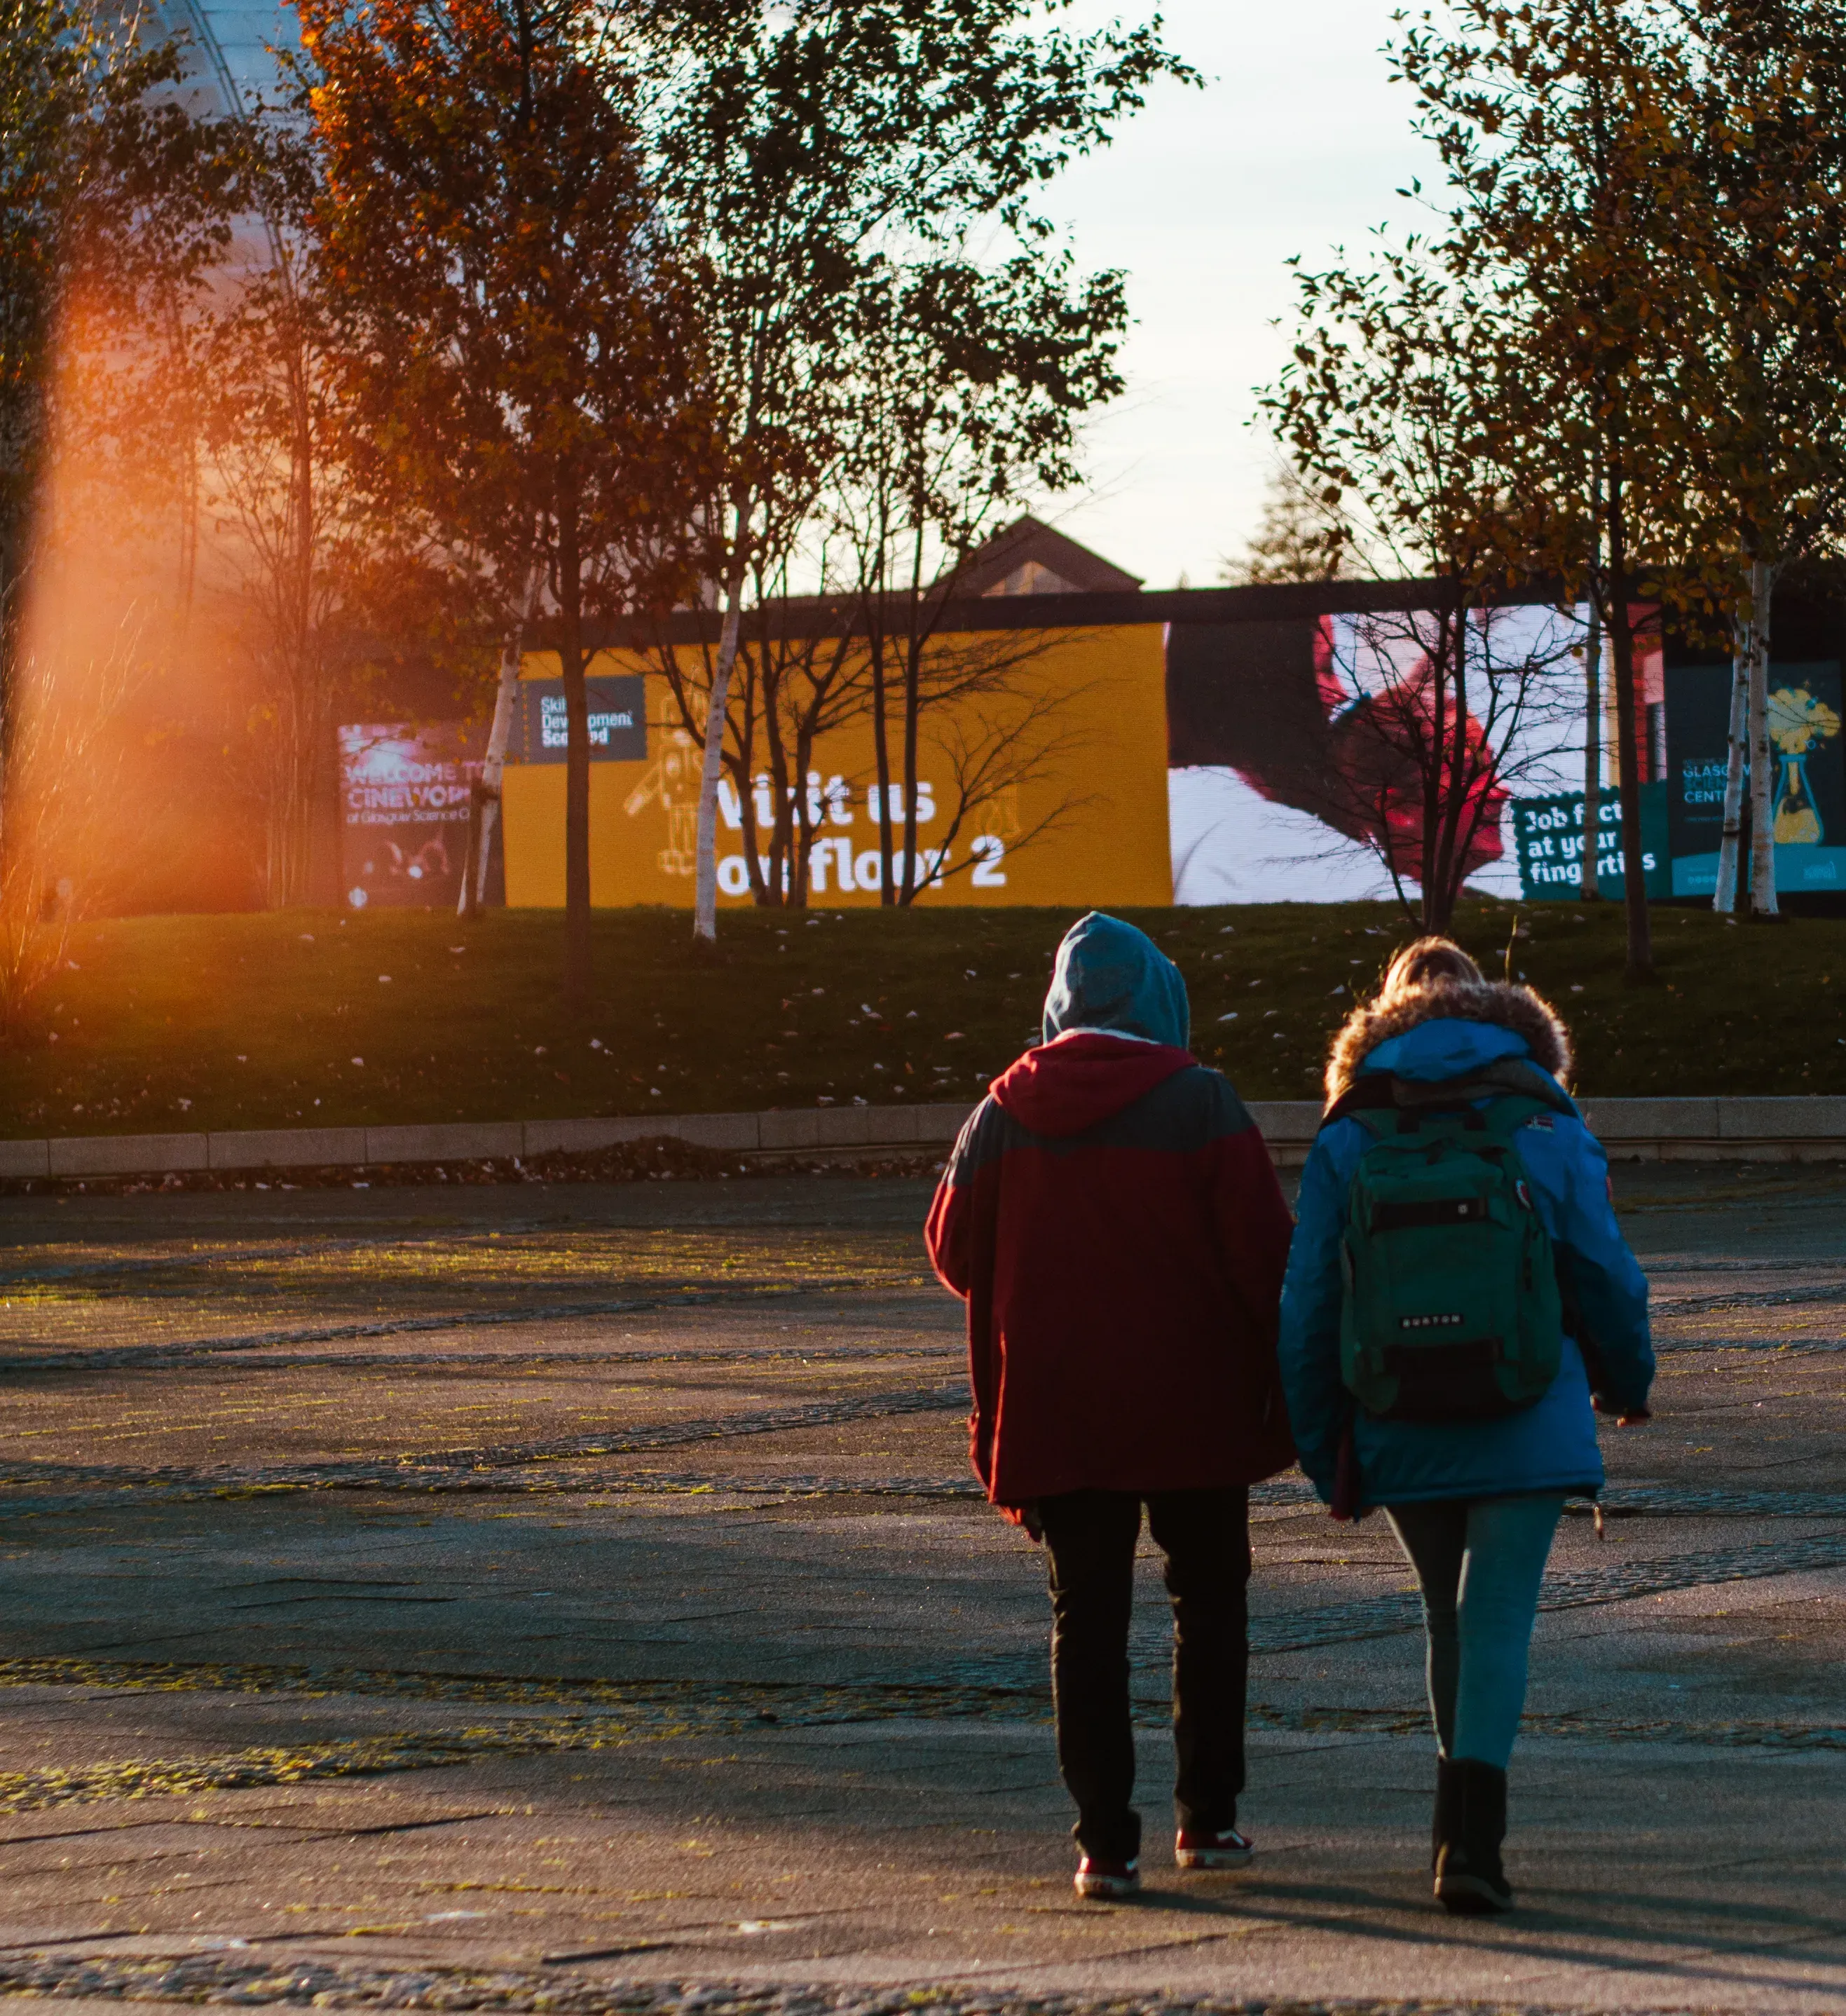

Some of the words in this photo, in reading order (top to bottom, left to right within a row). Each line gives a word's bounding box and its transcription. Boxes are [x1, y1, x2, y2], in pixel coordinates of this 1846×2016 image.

[345, 763, 457, 784] WELCOME
[867, 781, 936, 824] us
[1526, 806, 1568, 833] Job
[808, 836, 951, 892] floor
[971, 834, 1007, 888] 2
[1529, 836, 1555, 859] at
[1530, 850, 1657, 885] fingrtis
